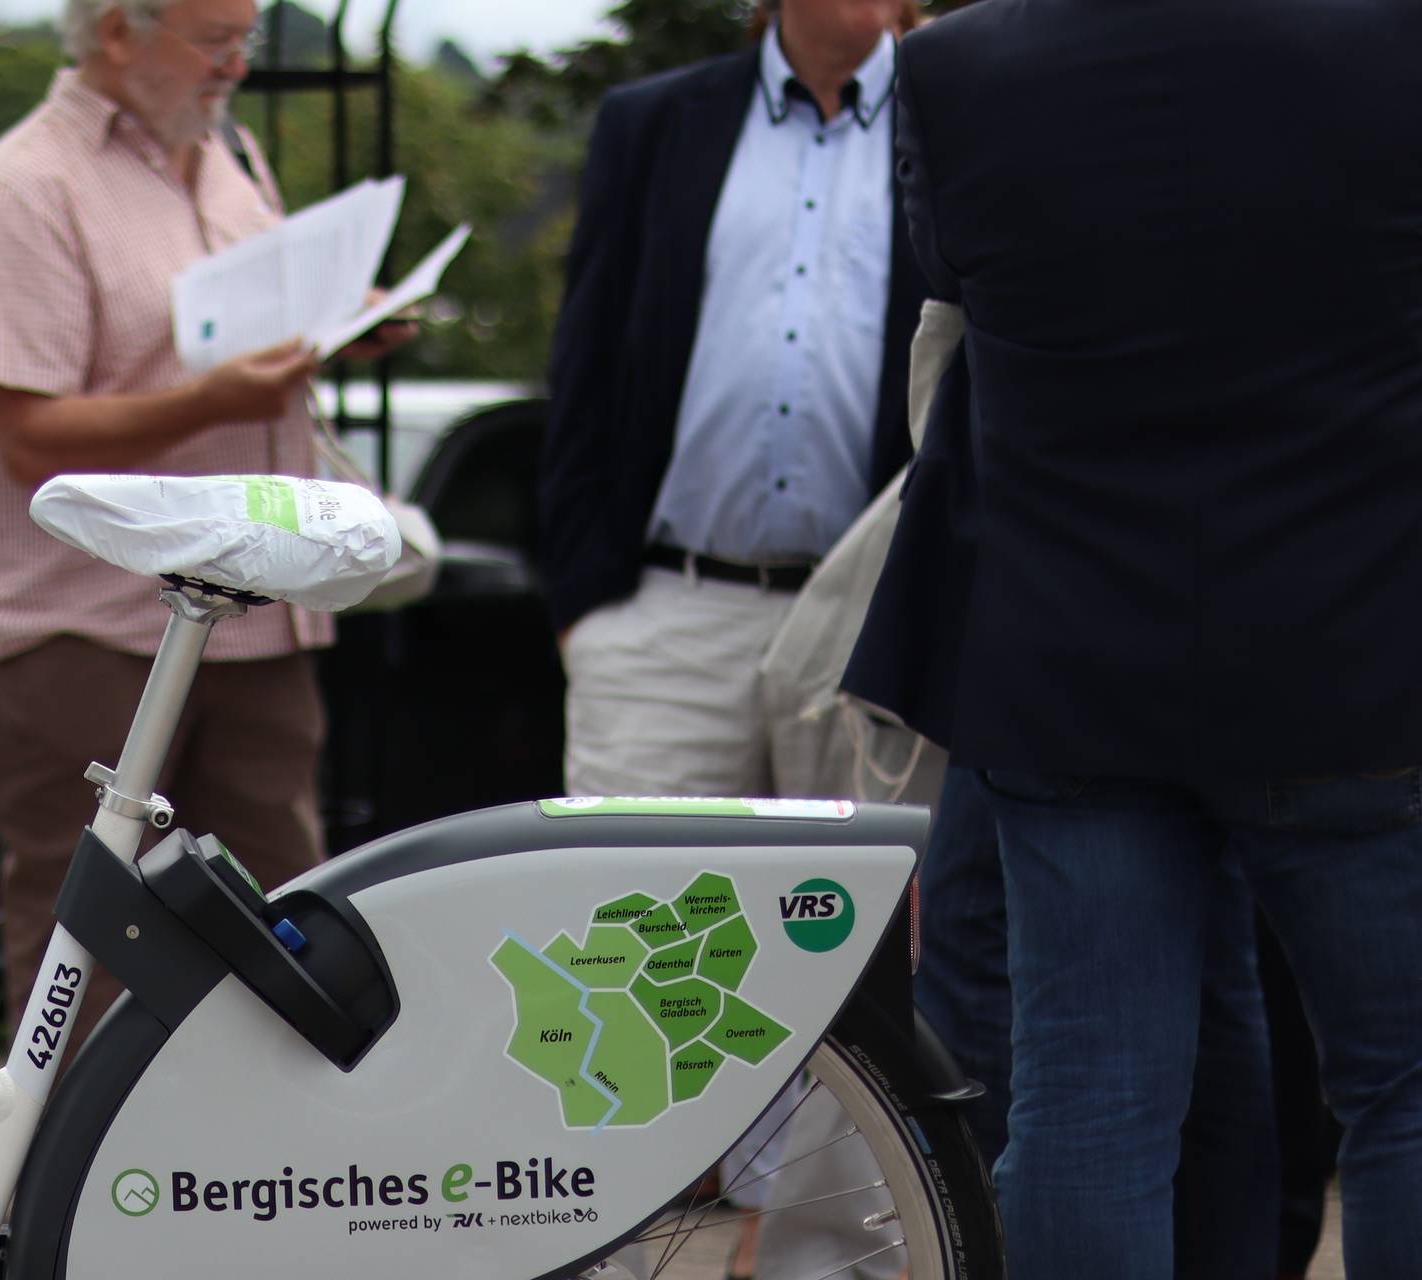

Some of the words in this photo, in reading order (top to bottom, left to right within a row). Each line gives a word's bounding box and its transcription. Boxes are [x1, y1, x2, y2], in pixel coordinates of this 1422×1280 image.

[684, 895, 731, 906] Wermels-
[779, 894, 836, 919] VRS
[597, 908, 653, 922] Leichlingen
[690, 904, 726, 916] kirchen
[638, 921, 687, 934] Burscheid
[709, 947, 742, 959] Kürten
[570, 954, 626, 966] Leverkusen
[647, 958, 694, 970] Odenthal
[660, 996, 702, 1009] Bergisch
[27, 963, 82, 1070] 42603
[660, 1007, 707, 1019] Gladbach
[540, 1028, 572, 1044] Köln
[725, 1027, 765, 1039] Overath
[676, 1059, 714, 1071] Rösrath
[594, 1070, 619, 1094] Rhein
[928, 1159, 949, 1194] DELTA
[172, 1165, 428, 1221] Bergisches
[441, 1157, 596, 1202] e-Bike
[348, 1215, 418, 1235] powered
[423, 1215, 441, 1232] by
[500, 1210, 572, 1225] nextbike
